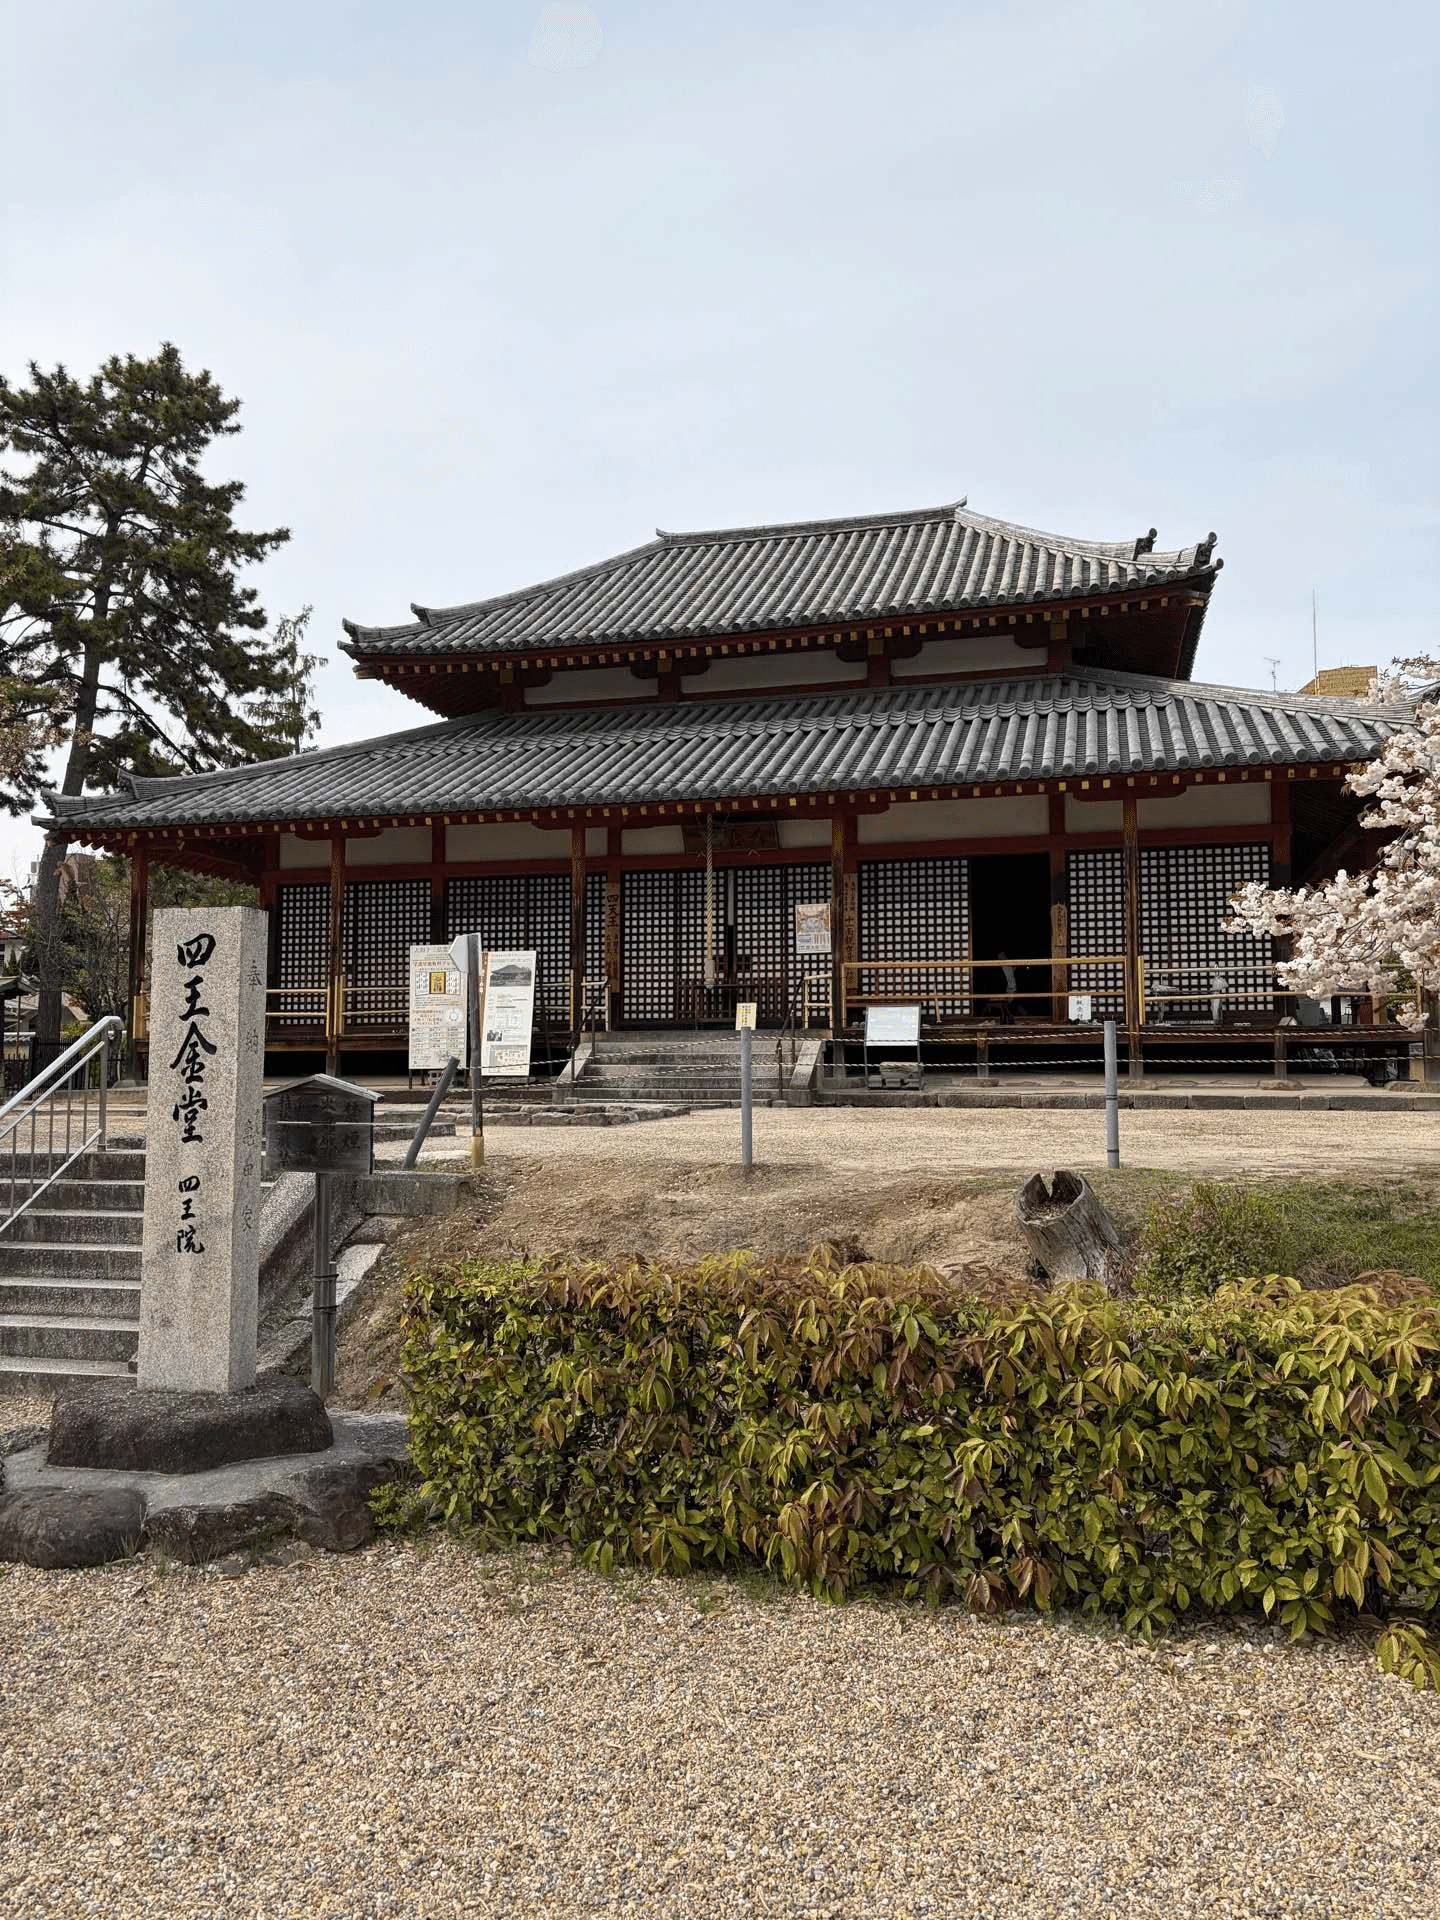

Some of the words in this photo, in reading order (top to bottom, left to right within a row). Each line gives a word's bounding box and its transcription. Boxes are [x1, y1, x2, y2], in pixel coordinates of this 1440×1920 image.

[170, 934, 216, 1143] 四王金堂
[177, 1176, 204, 1253] 四王院
